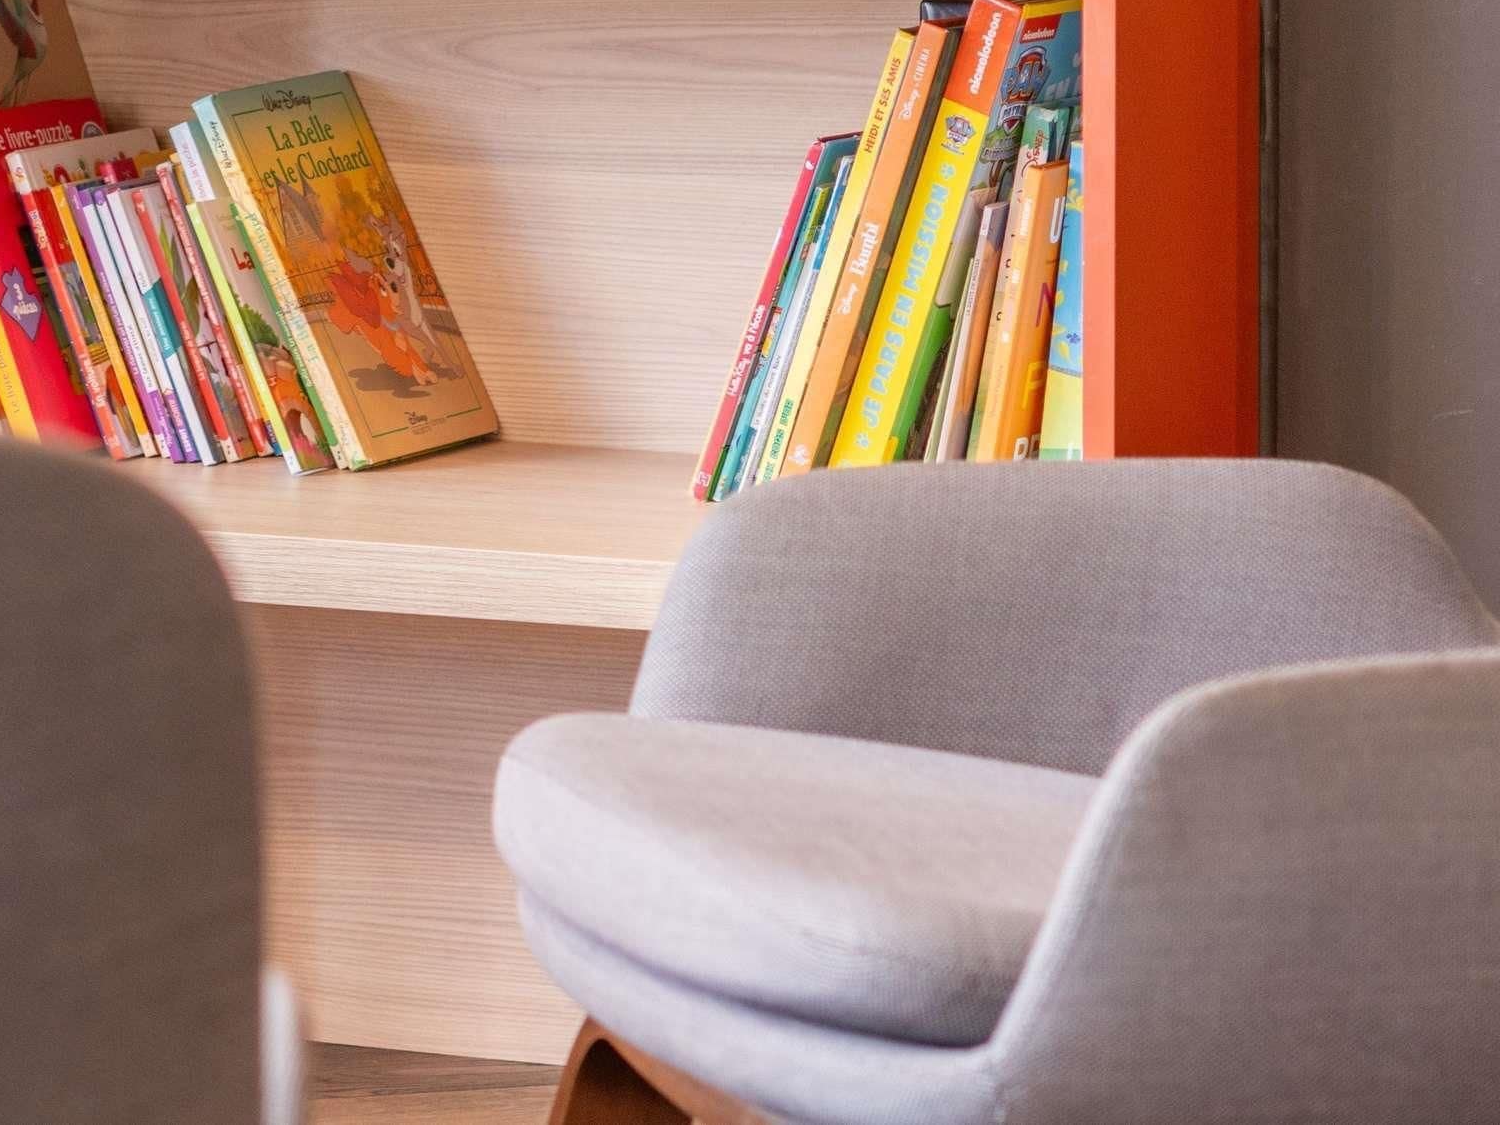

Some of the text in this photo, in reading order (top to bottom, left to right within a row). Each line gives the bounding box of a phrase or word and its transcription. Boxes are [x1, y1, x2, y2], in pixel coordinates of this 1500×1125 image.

[969, 10, 1003, 94] nickelodeon
[863, 56, 902, 153] HEIDI ET SES AMIS
[899, 88, 920, 120] Disney
[3, 120, 75, 149] livre-puzzle
[265, 114, 335, 152] La Belle
[262, 138, 372, 189] et le Clochard
[863, 183, 949, 428] JE PARS EN MISSION
[726, 374, 741, 396] Hello
